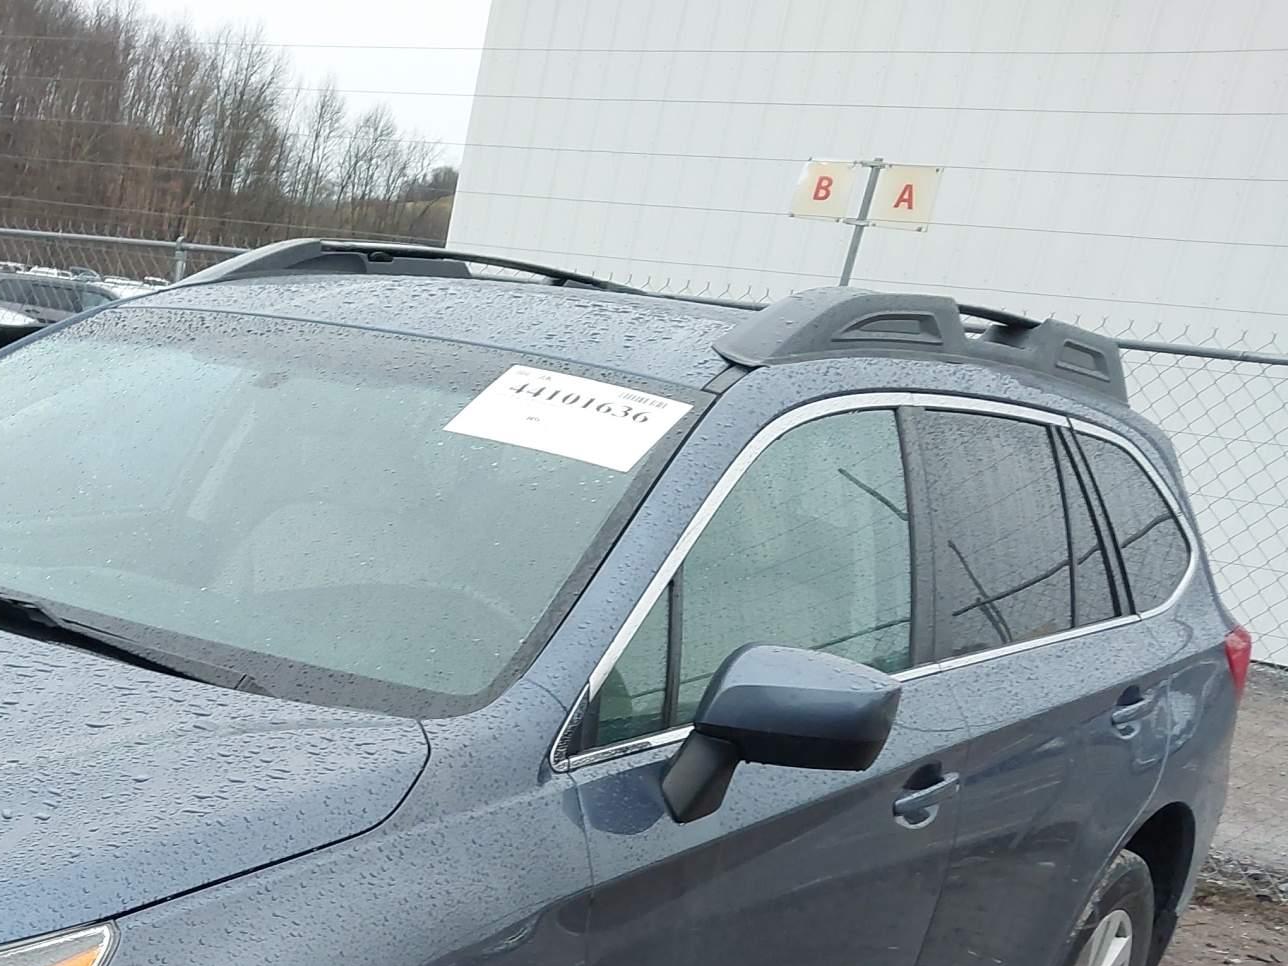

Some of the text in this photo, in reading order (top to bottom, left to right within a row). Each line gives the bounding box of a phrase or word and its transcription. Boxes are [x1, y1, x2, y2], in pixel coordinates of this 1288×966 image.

[813, 175, 833, 201] B
[893, 184, 914, 210] A
[509, 383, 651, 424] 44101636
